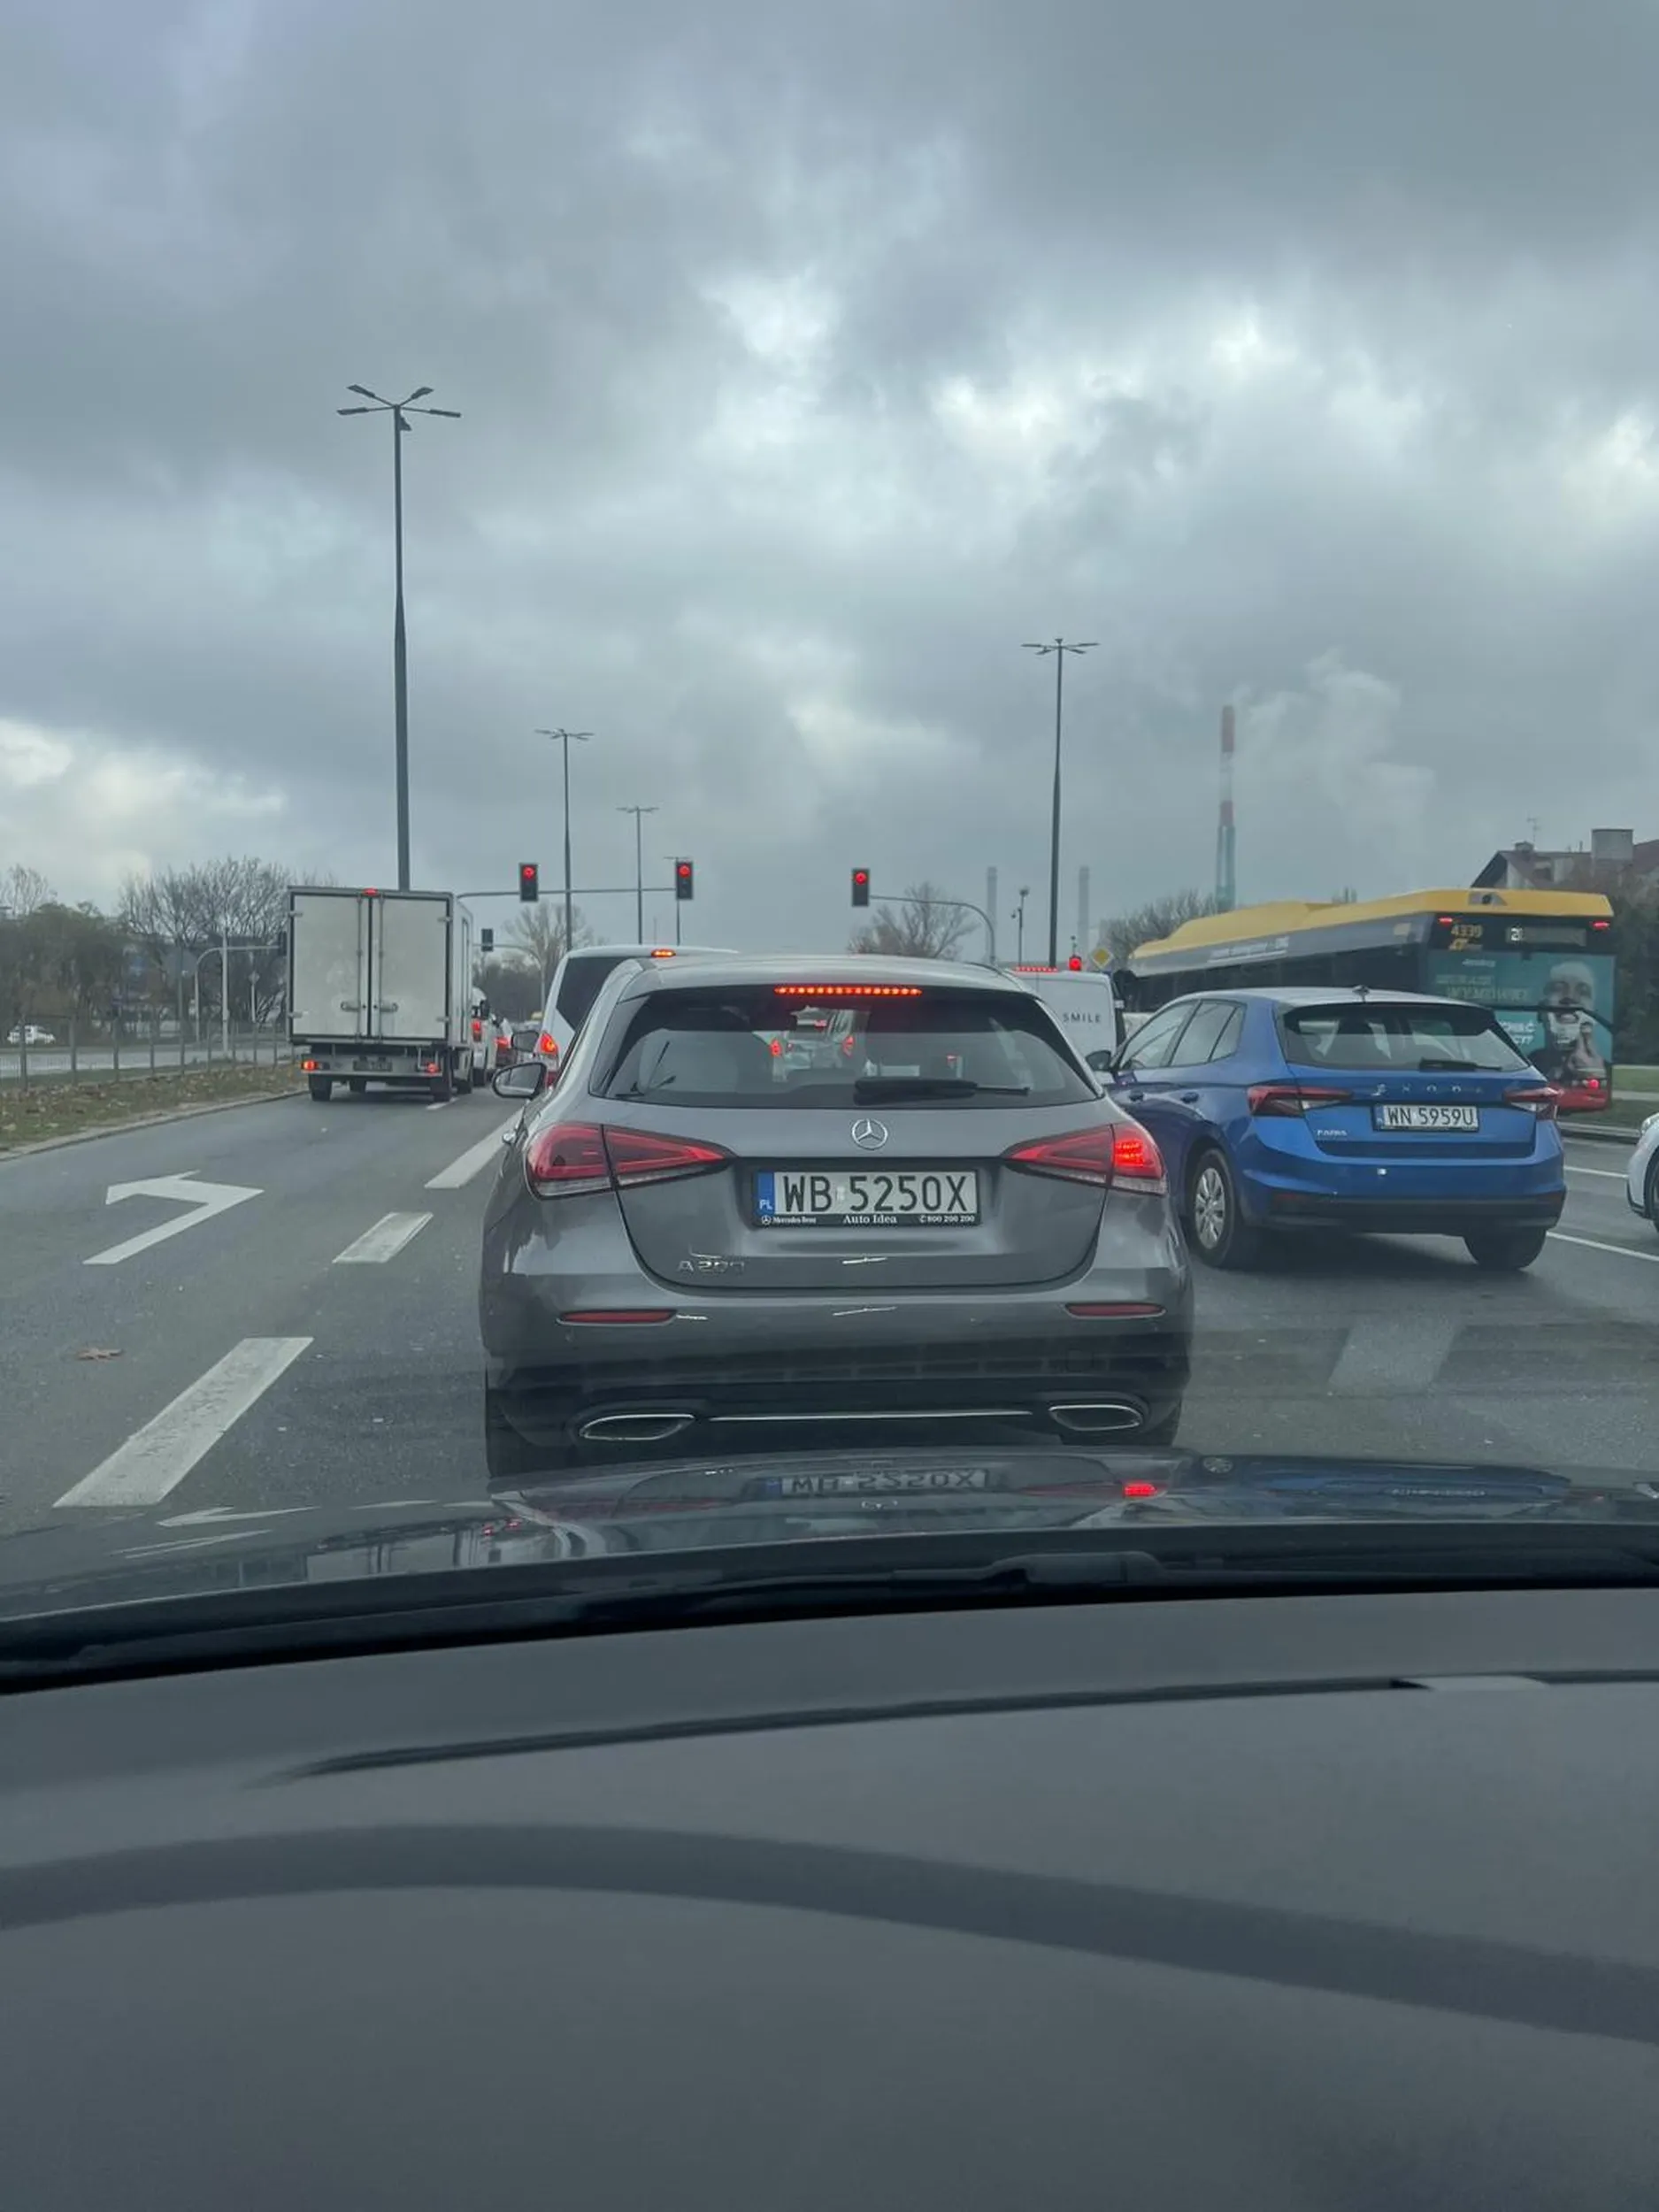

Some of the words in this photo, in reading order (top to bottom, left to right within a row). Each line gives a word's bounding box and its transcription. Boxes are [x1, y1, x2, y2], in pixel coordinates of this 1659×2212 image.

[1063, 1012, 1101, 1023] SMILE
[1387, 1107, 1412, 1125] WN
[1418, 1107, 1473, 1125] 5959U
[783, 1175, 833, 1212] WB
[849, 1175, 967, 1212] 5250X
[759, 1199, 773, 1210] PL
[843, 1215, 870, 1224] Auto
[873, 1215, 898, 1224] Idea
